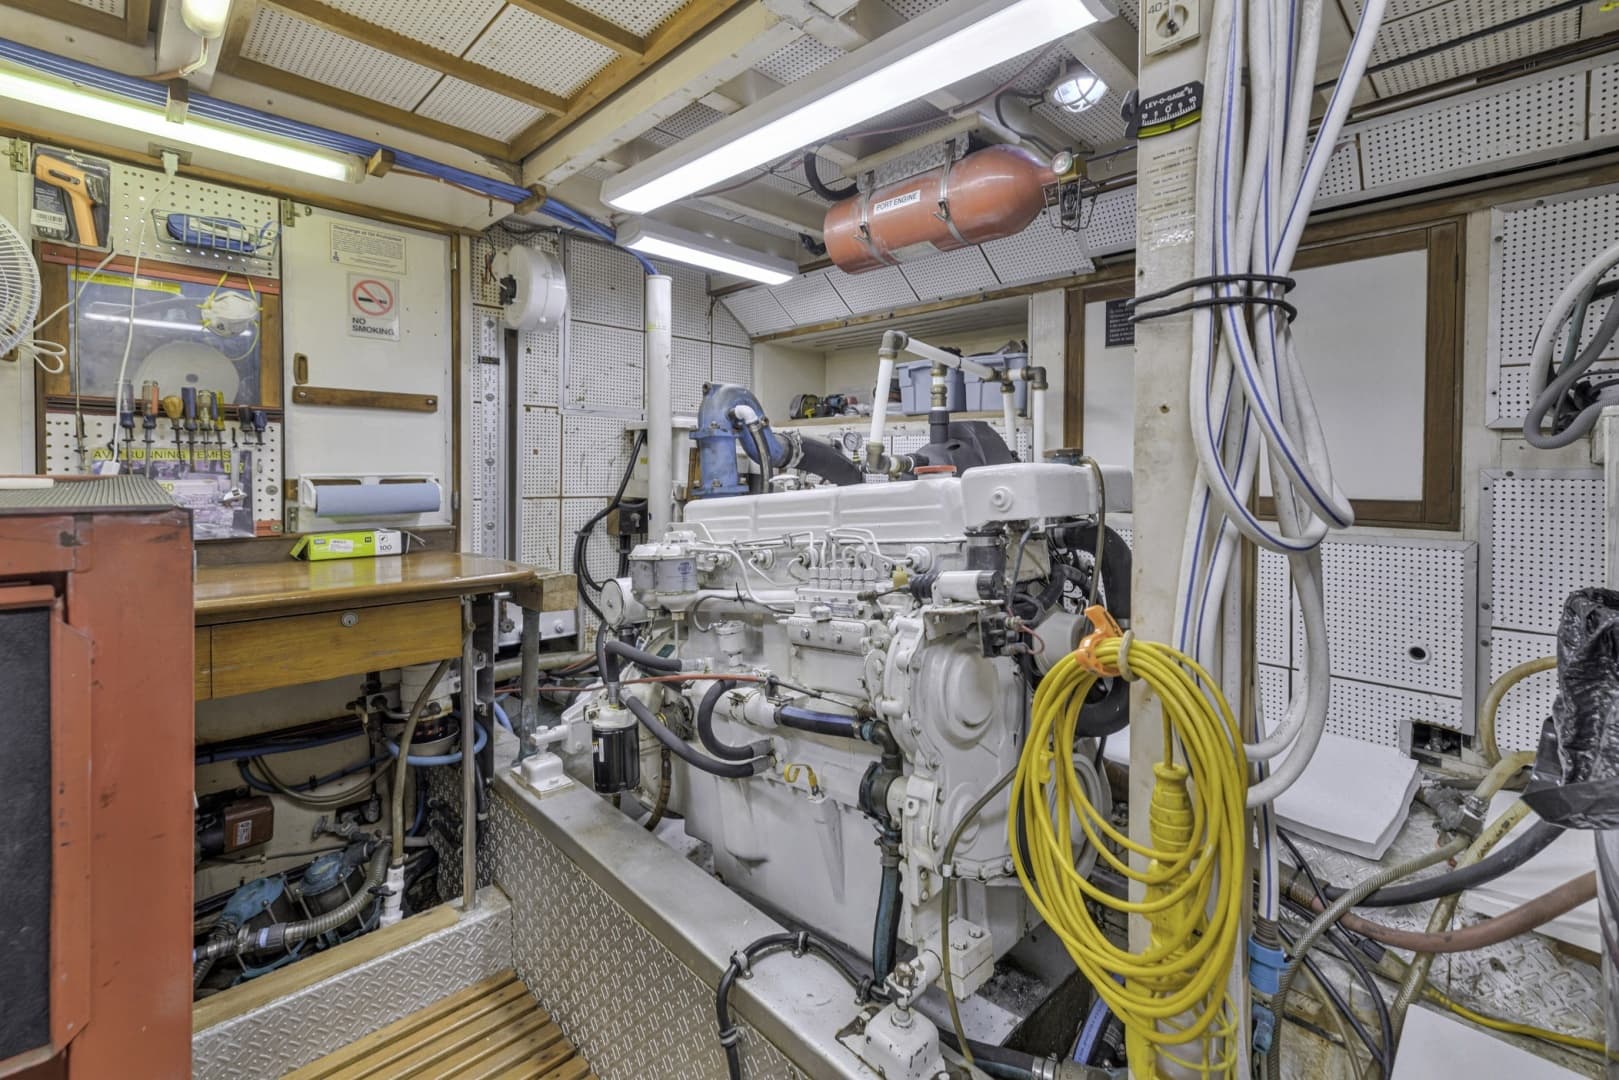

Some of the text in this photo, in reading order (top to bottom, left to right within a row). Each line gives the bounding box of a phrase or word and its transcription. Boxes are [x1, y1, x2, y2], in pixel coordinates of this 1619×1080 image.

[876, 192, 918, 210] PORT ENGINE
[352, 317, 366, 325] NO
[352, 325, 394, 335] SMOKING
[127, 450, 187, 459] UNING
